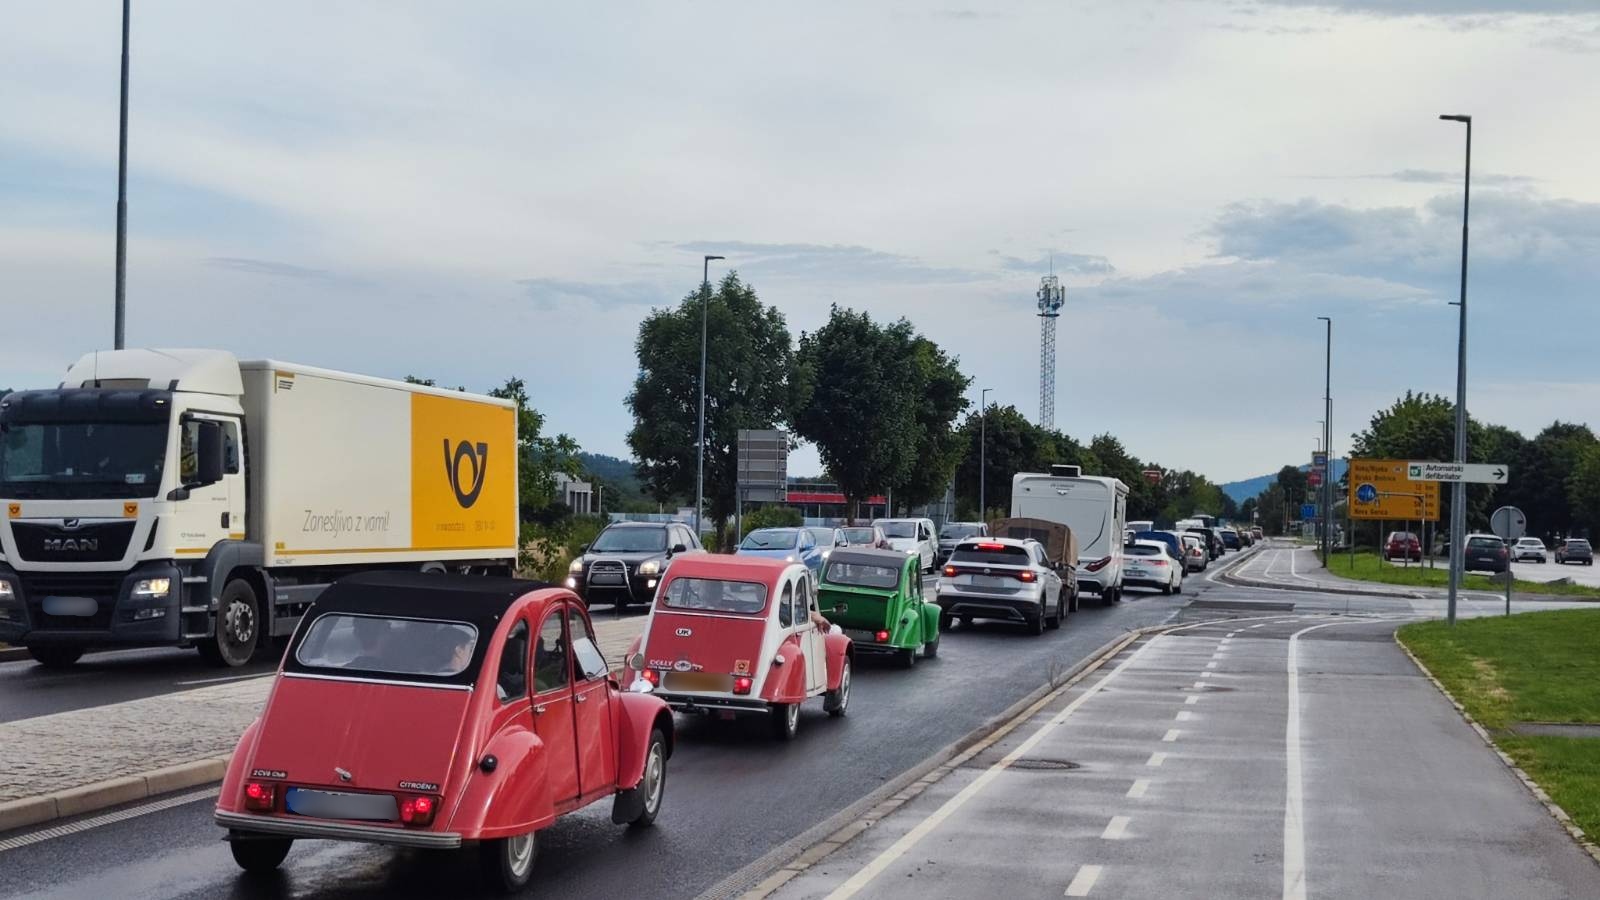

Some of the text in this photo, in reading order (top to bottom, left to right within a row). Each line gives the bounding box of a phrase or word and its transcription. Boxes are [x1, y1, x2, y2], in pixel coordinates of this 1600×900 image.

[1425, 464, 1464, 472] Avtomatski
[1425, 472, 1462, 480] defibrilator
[302, 509, 391, 538] Zanesljivo z vami!
[44, 538, 98, 551] MAN
